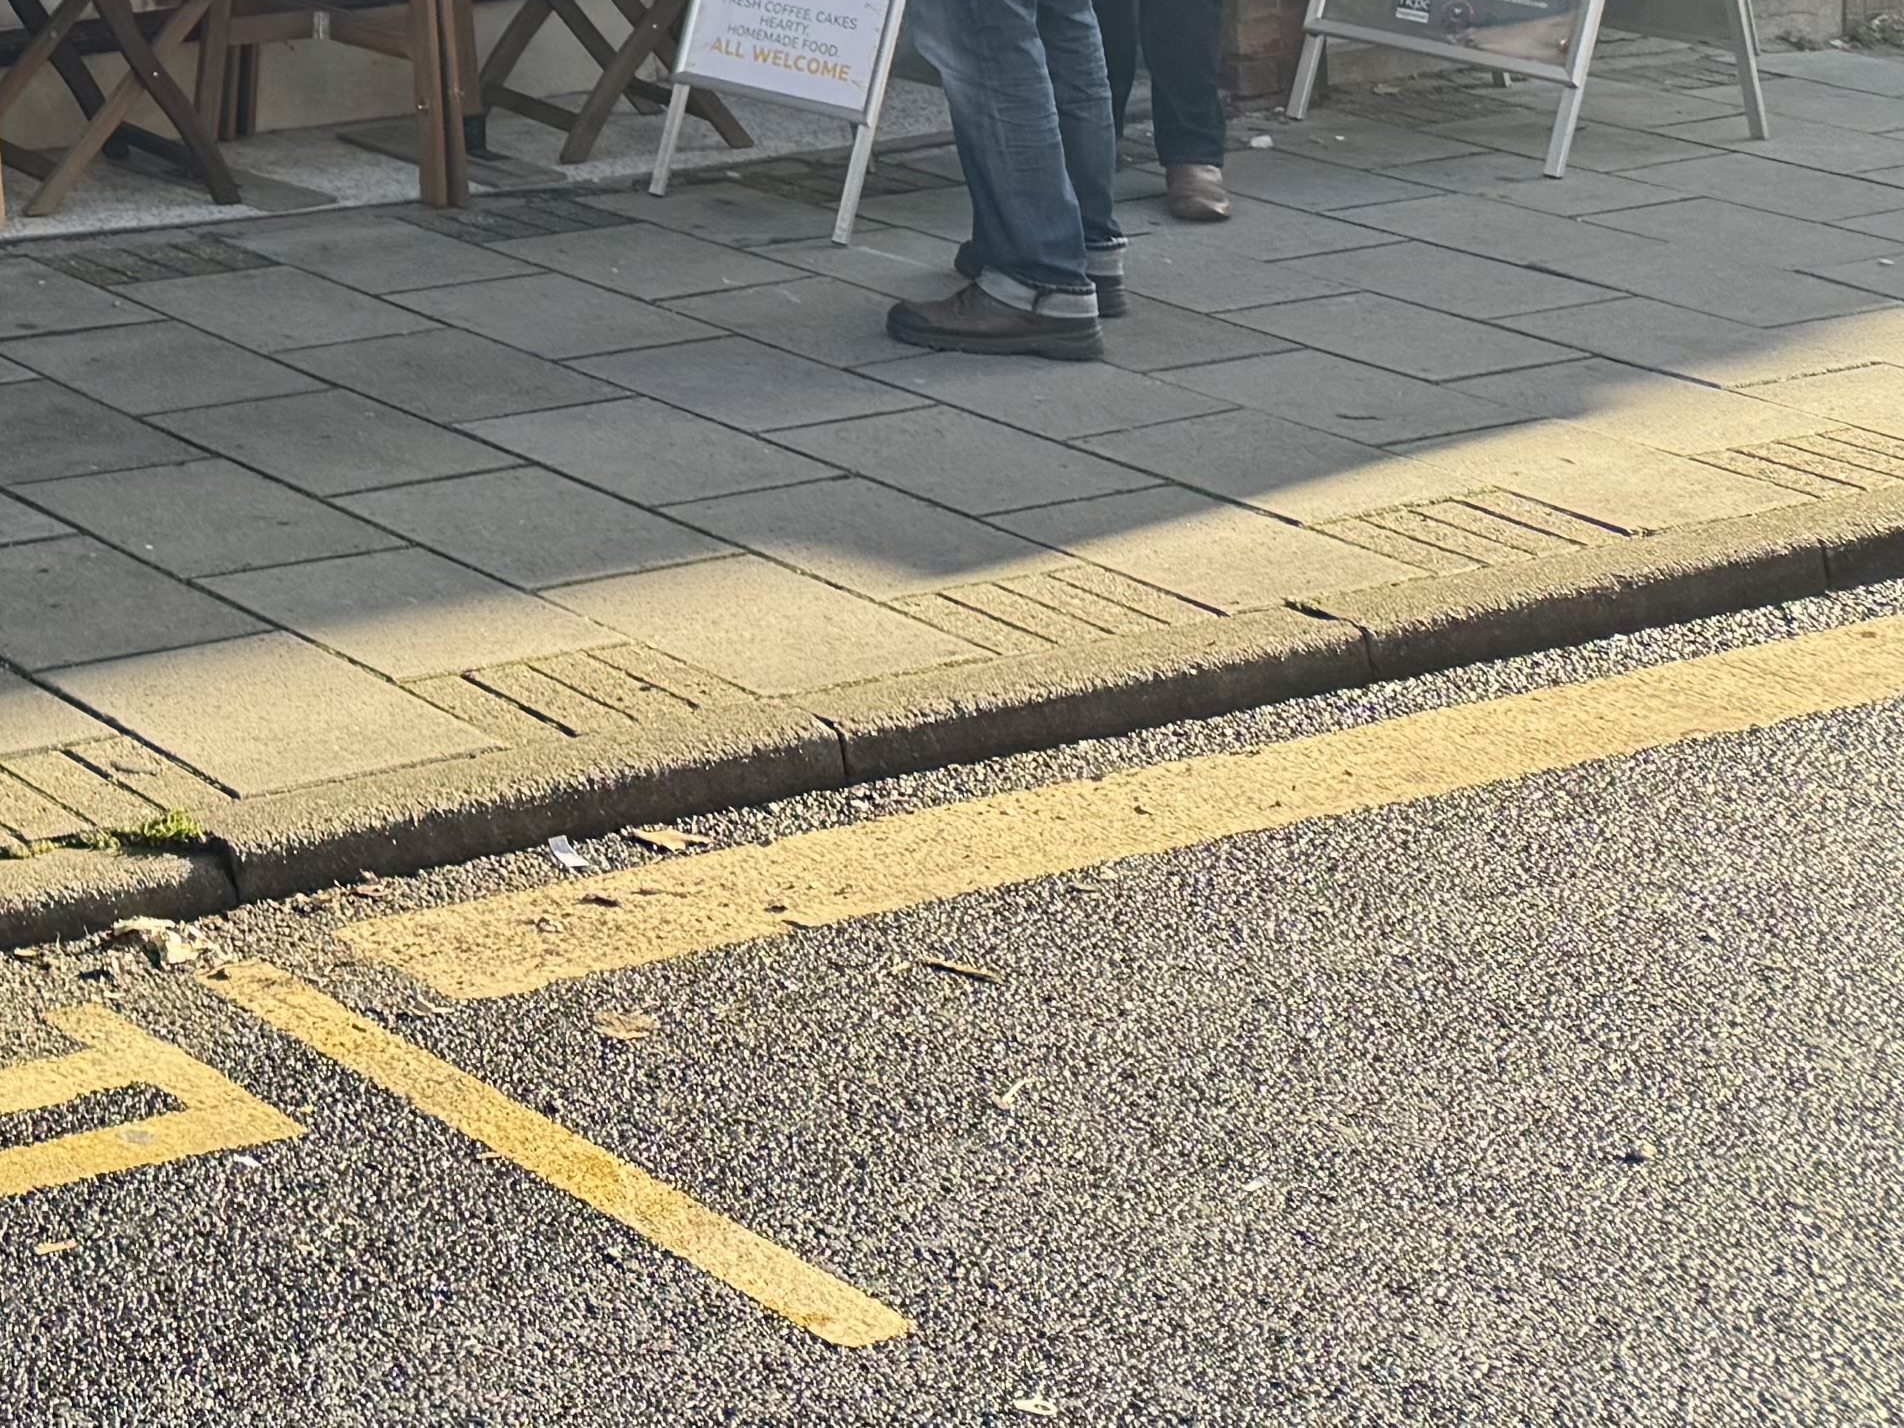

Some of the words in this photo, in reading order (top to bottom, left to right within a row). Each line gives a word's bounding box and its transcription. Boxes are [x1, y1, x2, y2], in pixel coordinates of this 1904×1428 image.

[815, 10, 859, 31] CAKES
[727, 23, 800, 50] HOMEMADE
[709, 36, 745, 59] ALL
[751, 45, 852, 83] WELCOME
